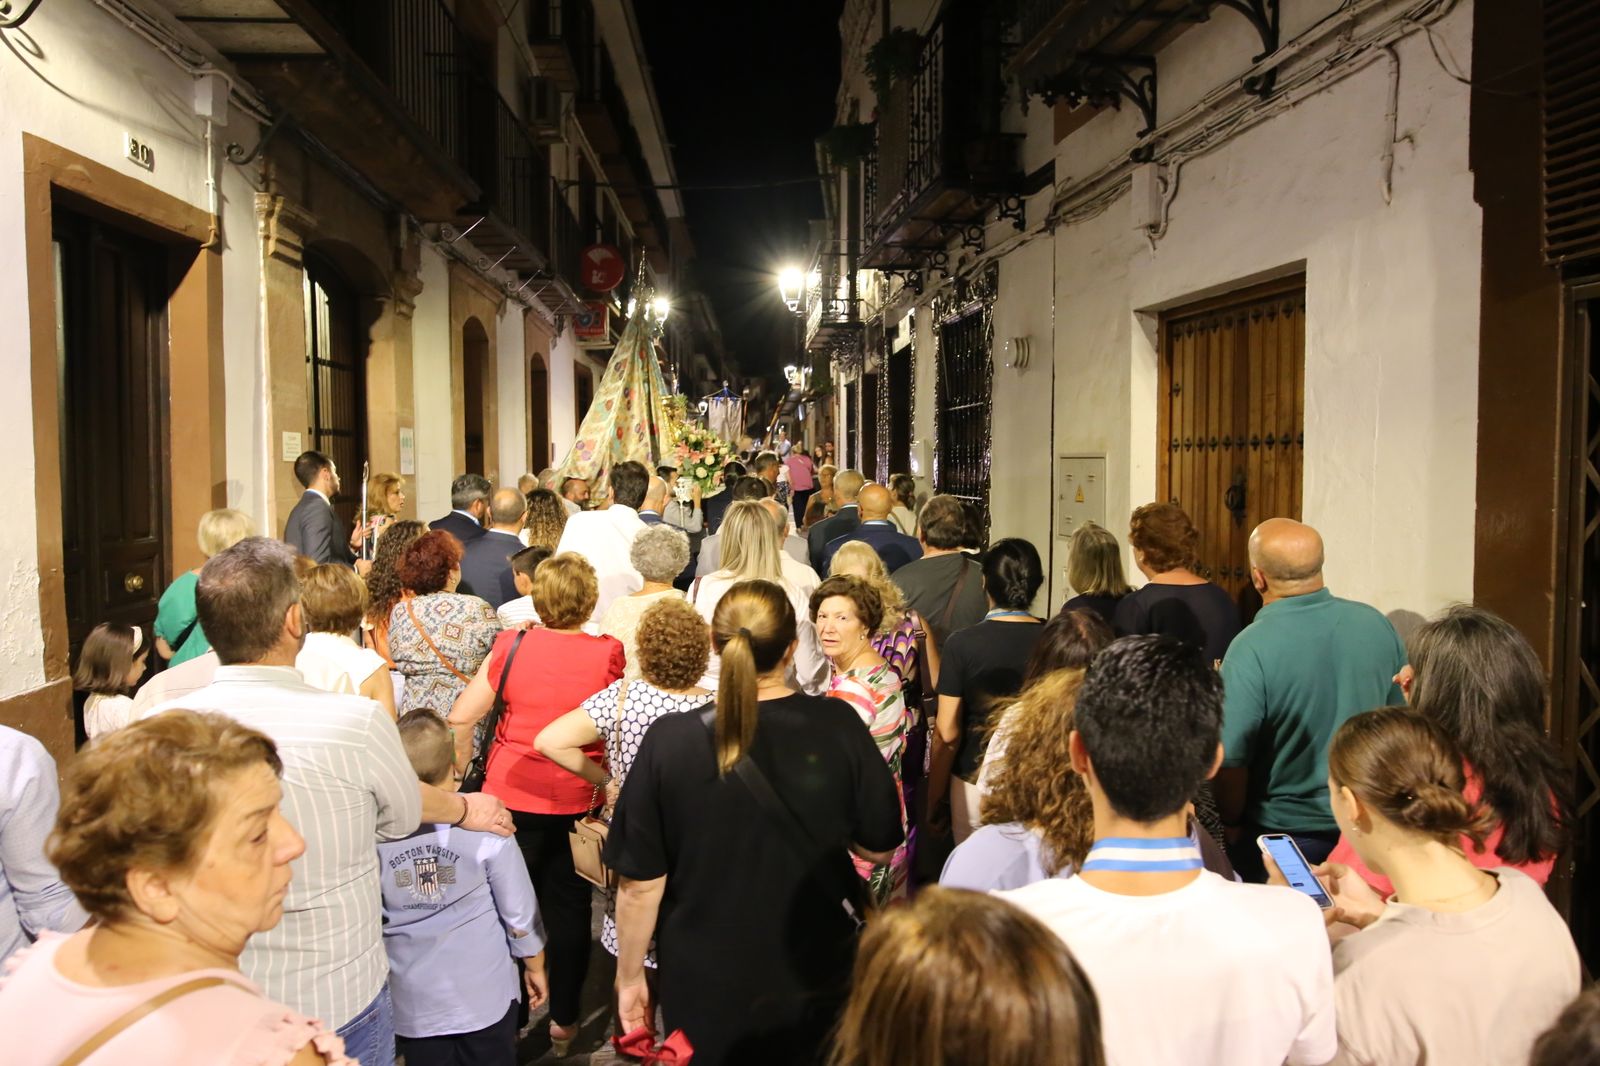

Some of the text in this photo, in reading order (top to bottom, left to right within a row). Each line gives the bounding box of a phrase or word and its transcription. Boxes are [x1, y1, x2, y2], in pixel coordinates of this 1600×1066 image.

[389, 845, 460, 869] BOSTON VARSITY
[437, 865, 456, 884] 22
